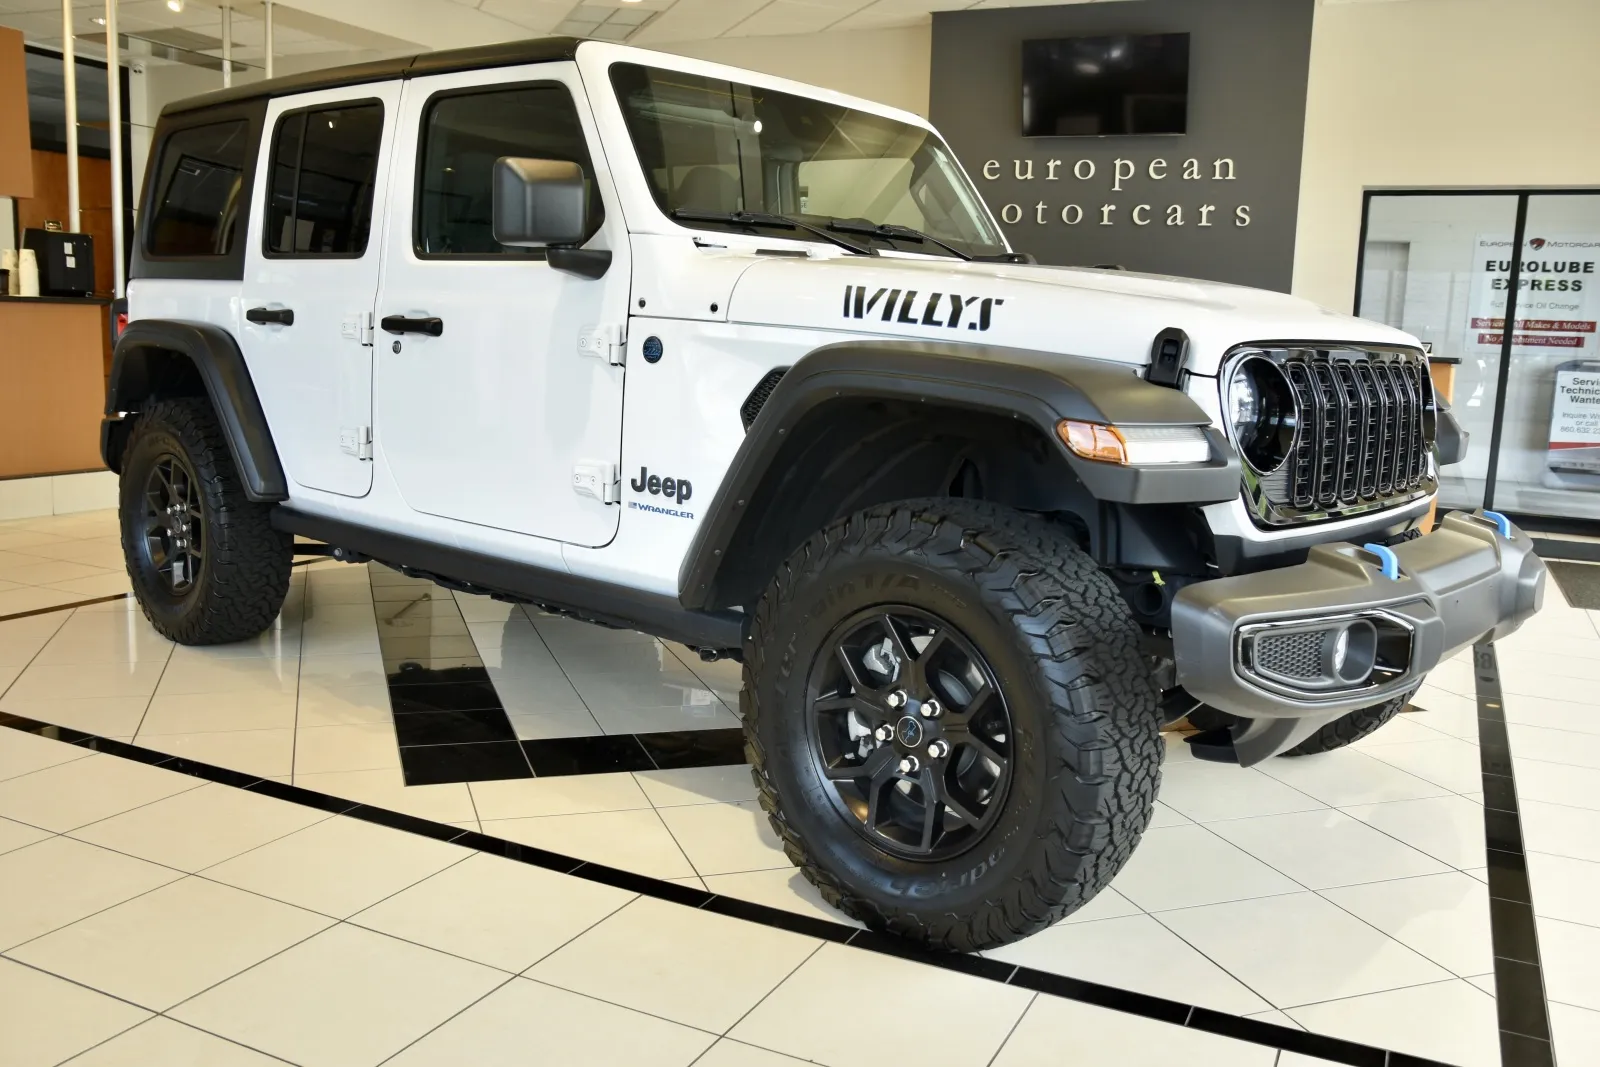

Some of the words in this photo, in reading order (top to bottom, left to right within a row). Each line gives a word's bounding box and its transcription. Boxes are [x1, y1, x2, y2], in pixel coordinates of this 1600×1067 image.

[983, 156, 1236, 191] european
[1001, 200, 1251, 227] otorcars
[843, 285, 1004, 331] WILLYS
[1549, 302, 1580, 312] Change
[1526, 321, 1551, 329] Makes
[1562, 321, 1591, 330] Models
[1547, 335, 1578, 345] Needed
[1572, 377, 1600, 385] Servi
[630, 466, 693, 505] Jeep
[637, 502, 695, 520] WRANGLER
